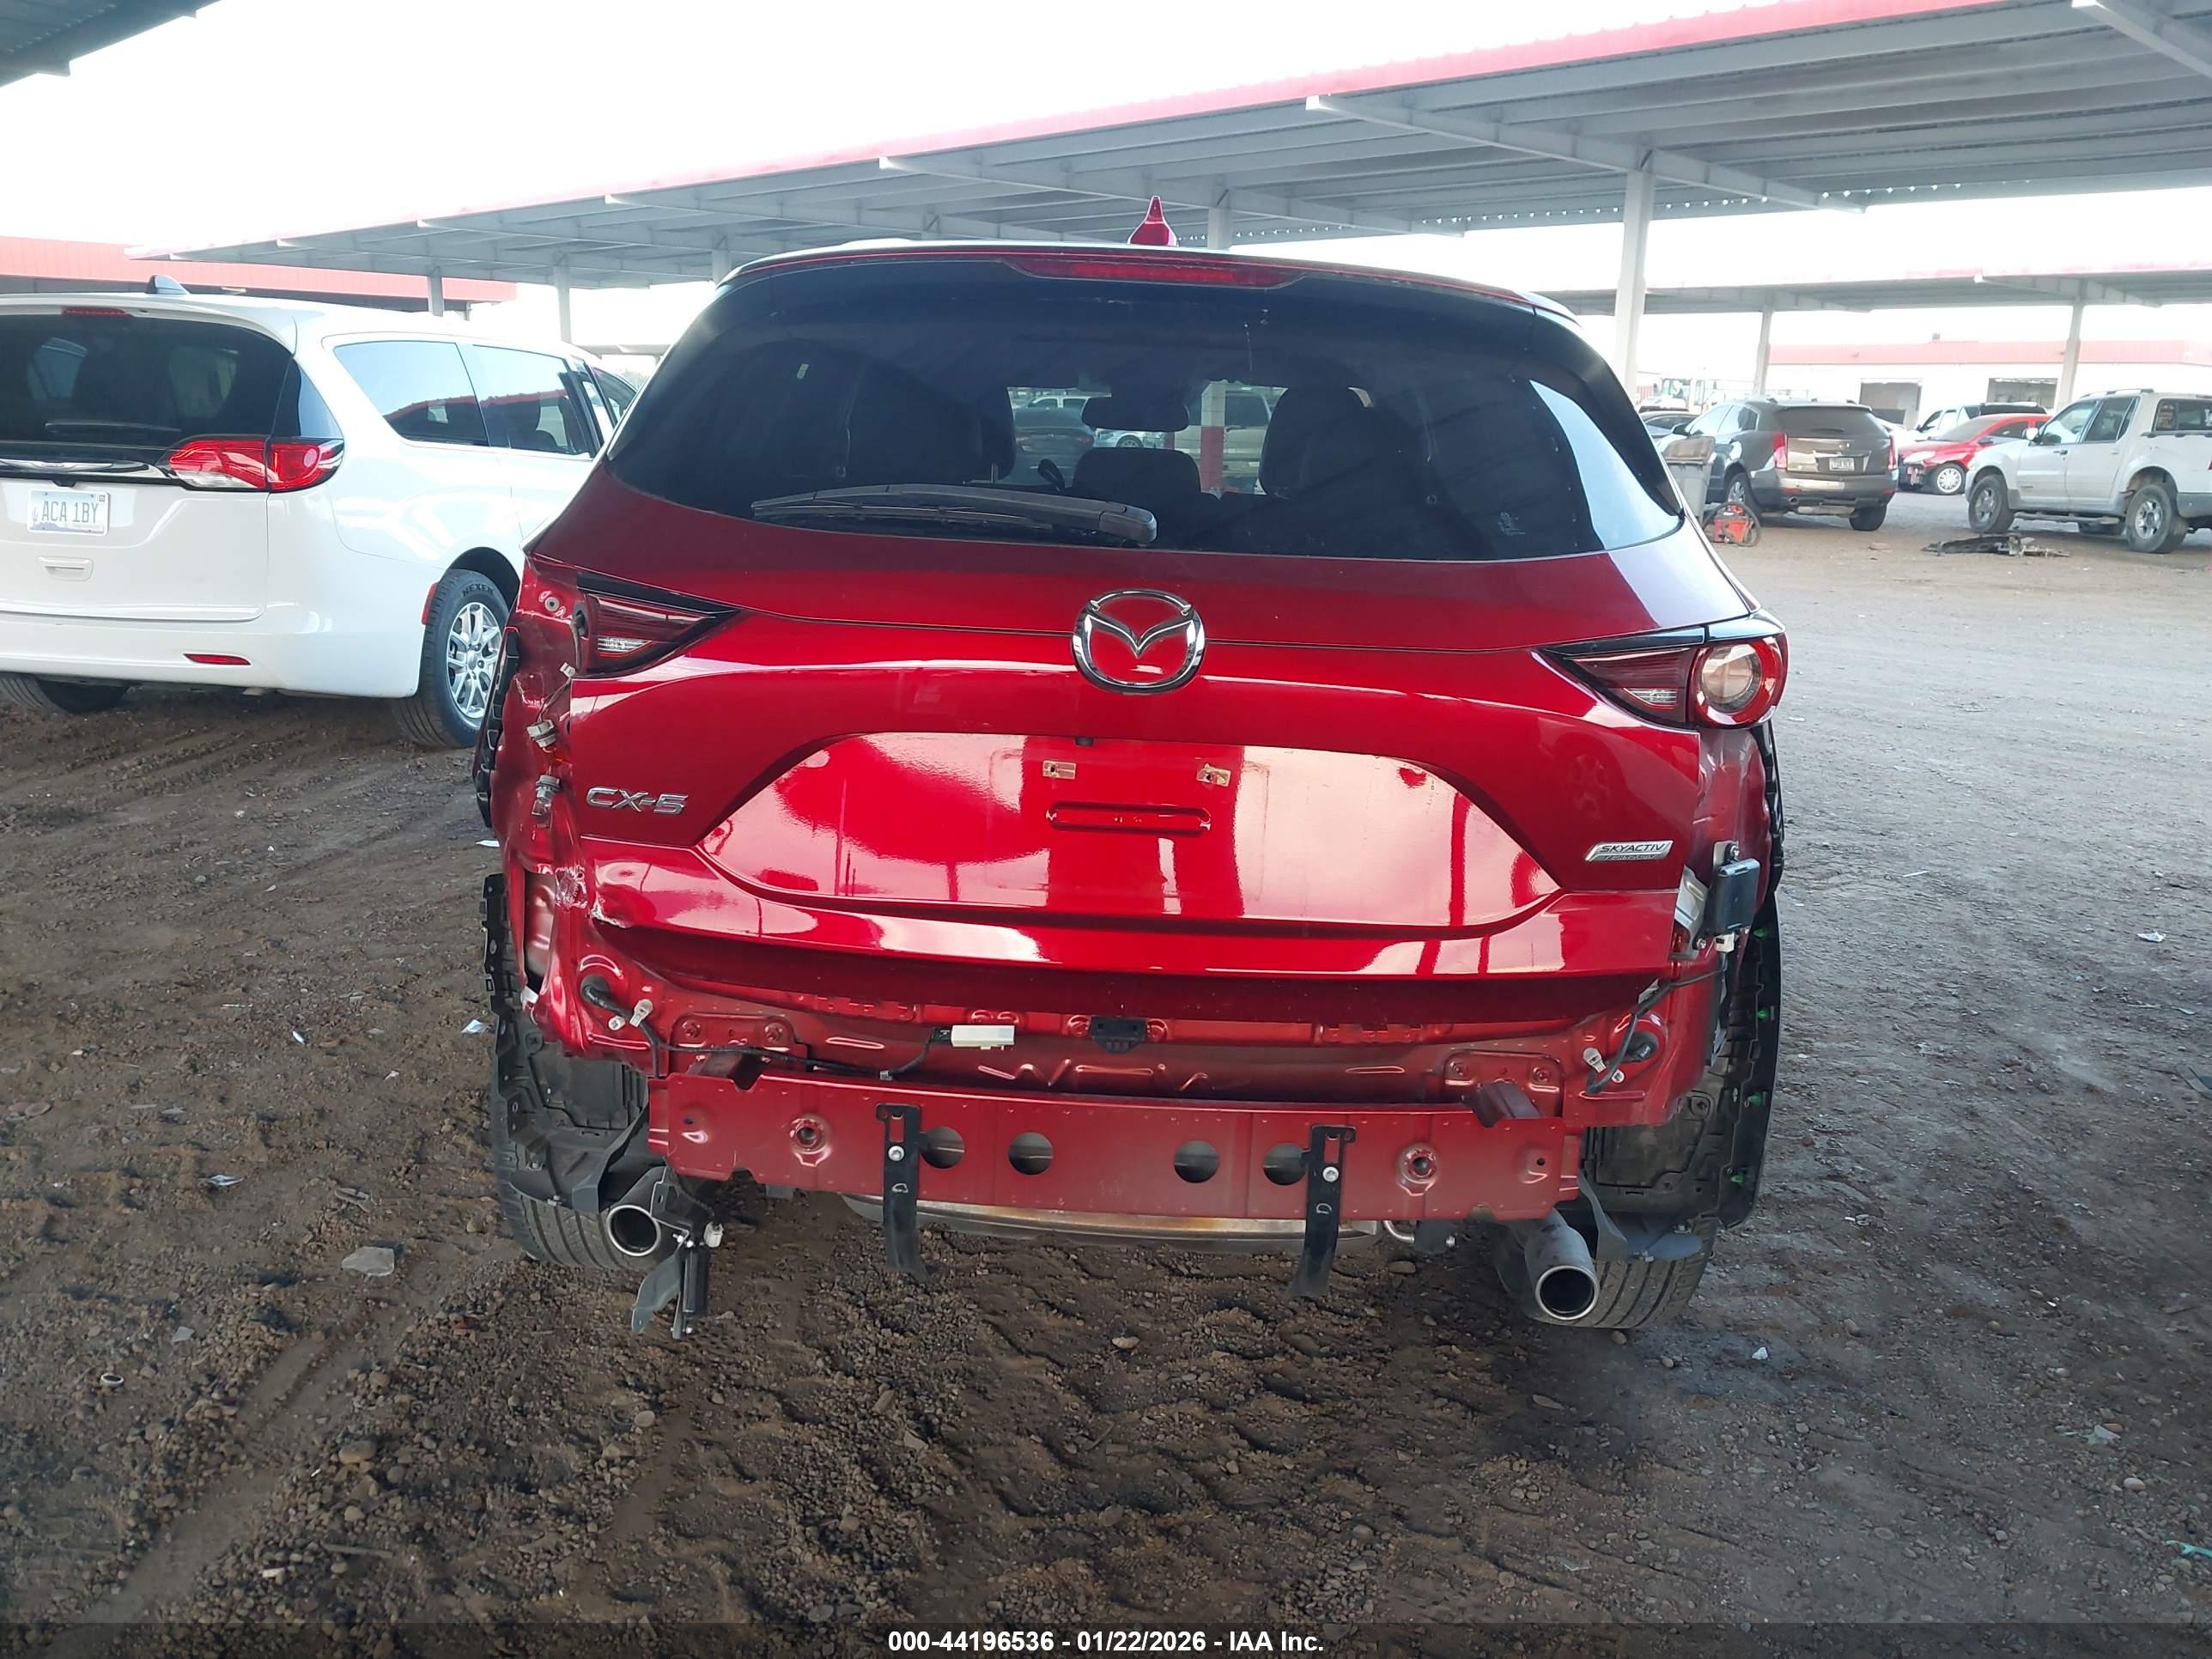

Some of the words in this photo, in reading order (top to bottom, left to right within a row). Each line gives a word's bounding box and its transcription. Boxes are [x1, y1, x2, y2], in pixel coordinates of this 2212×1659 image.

[41, 501, 67, 522] ACA
[72, 501, 99, 523] 1BY
[586, 787, 689, 815] CX-5
[1600, 844, 1665, 853] SKYACTIV
